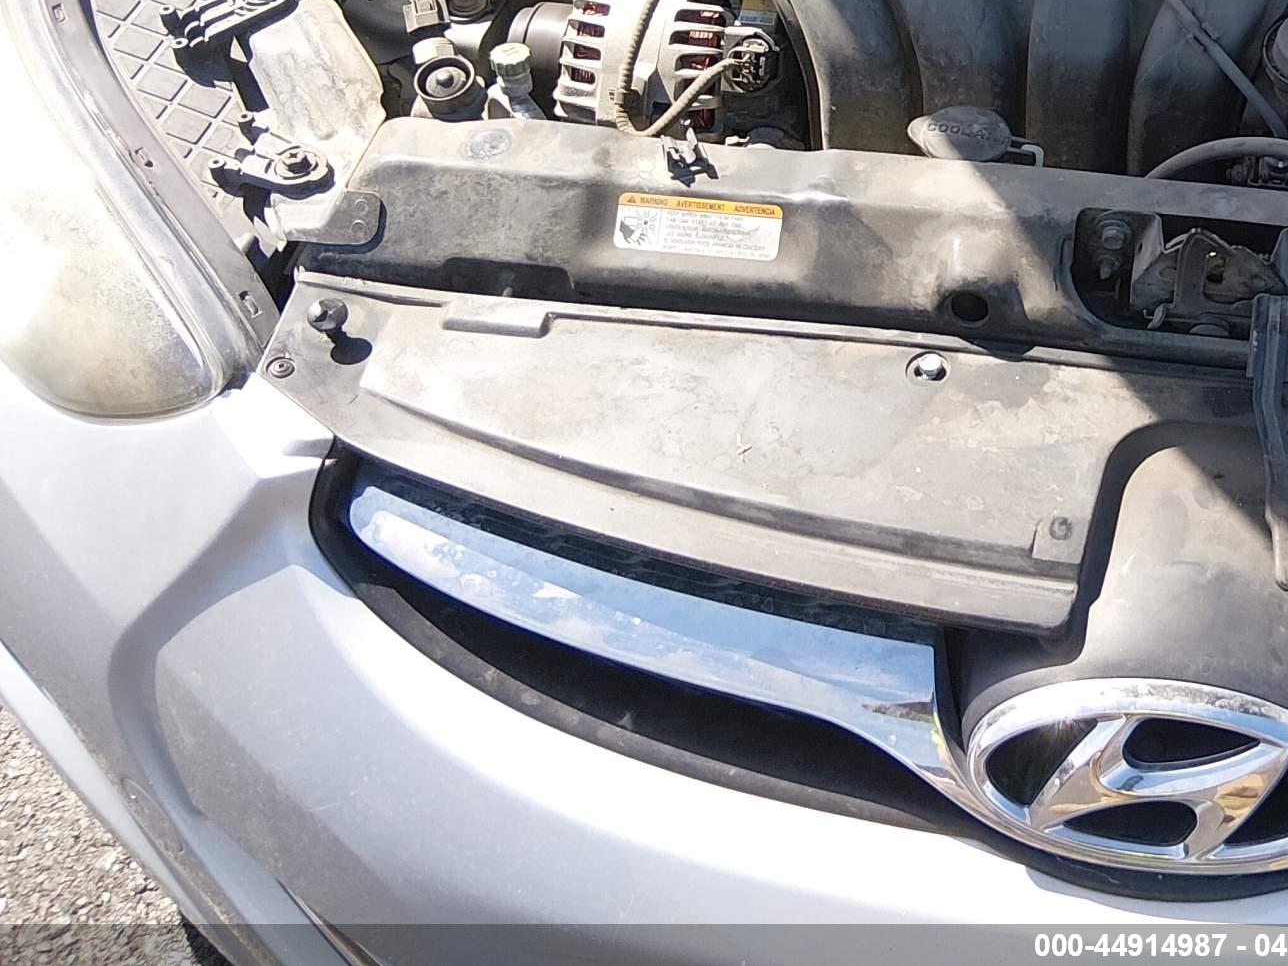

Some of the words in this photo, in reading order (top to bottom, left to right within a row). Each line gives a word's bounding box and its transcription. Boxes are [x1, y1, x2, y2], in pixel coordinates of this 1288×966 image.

[639, 196, 669, 206] WARNING
[676, 199, 726, 211] AVERTISSEMENT
[734, 204, 775, 216] ADVERTENCIA
